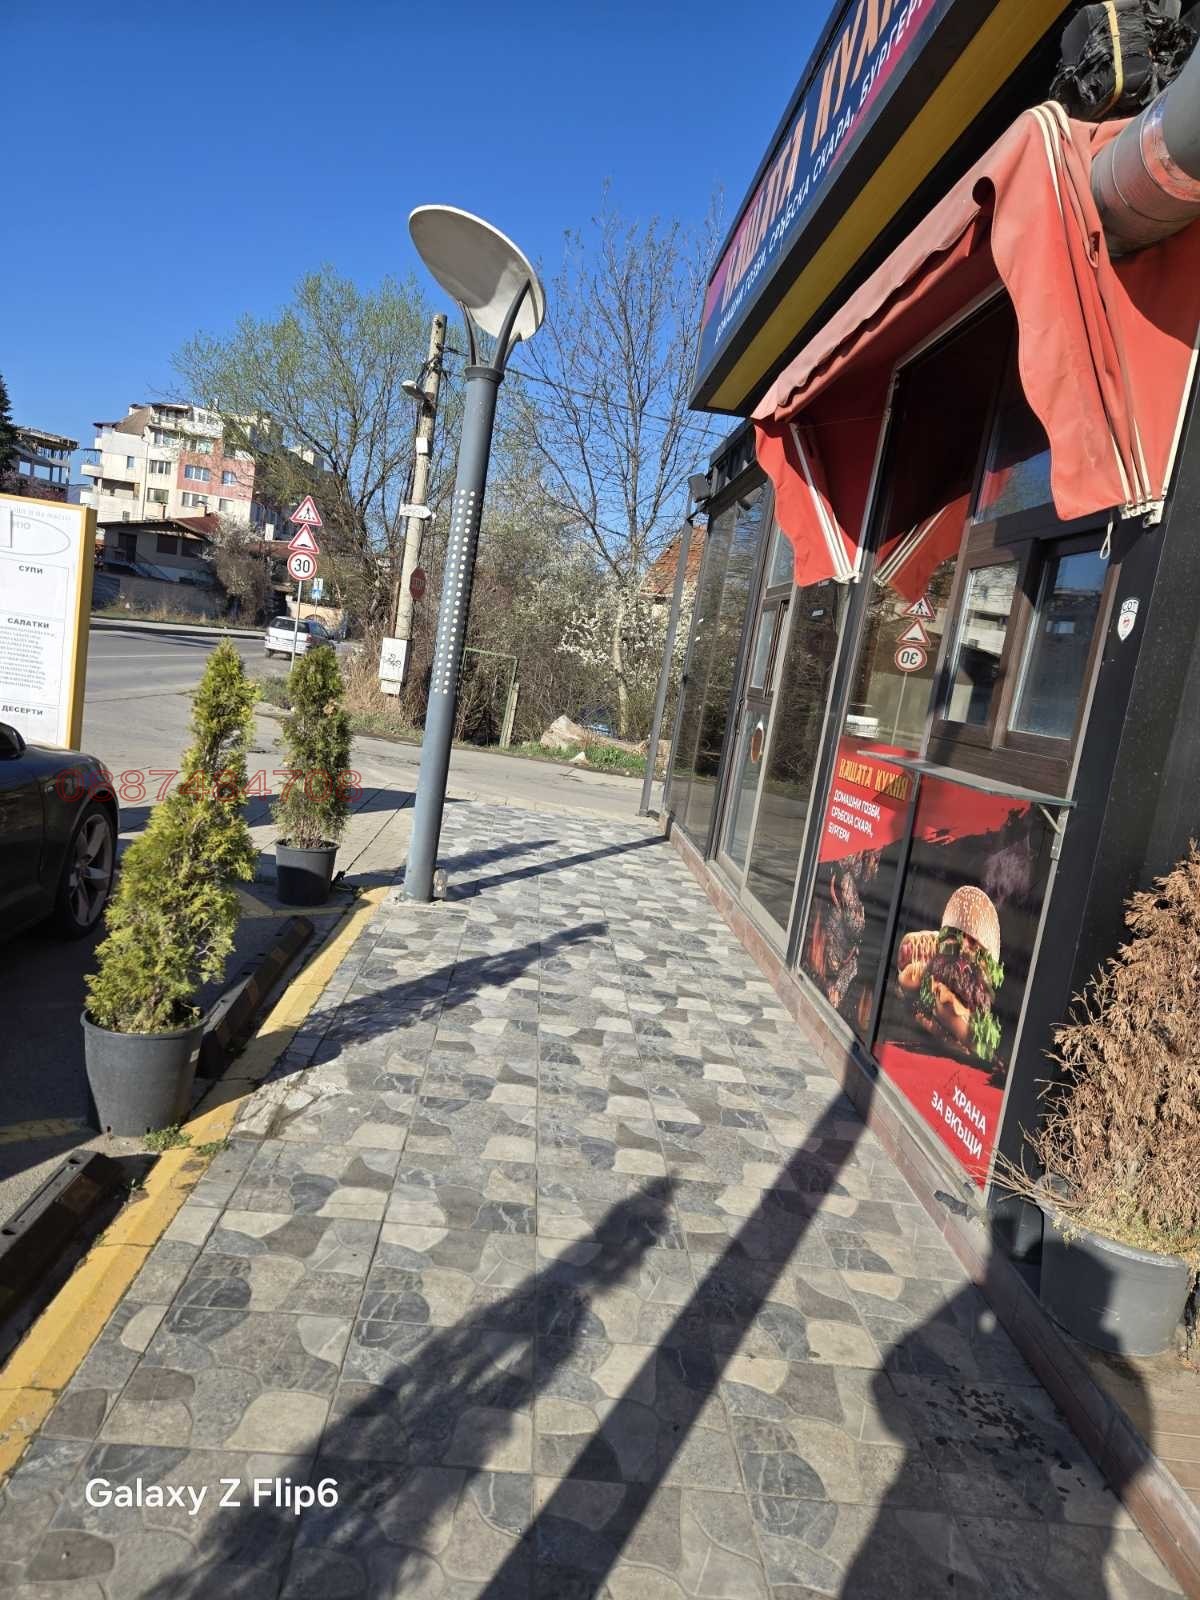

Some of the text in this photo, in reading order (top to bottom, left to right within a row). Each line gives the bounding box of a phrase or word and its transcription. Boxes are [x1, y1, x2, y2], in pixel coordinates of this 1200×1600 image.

[812, 105, 854, 183] СКАРА,
[858, 0, 923, 108] БУРГЕР
[18, 565, 43, 575] СУПИ
[294, 558, 310, 573] 30
[7, 617, 49, 628] САЛАТКИ
[2, 705, 43, 715] ДЕСЕРТИ
[874, 769, 909, 799] КУХНЯ
[952, 1085, 986, 1136] ХРАНА
[931, 1090, 983, 1160] ЗА ВКЪЩИ
